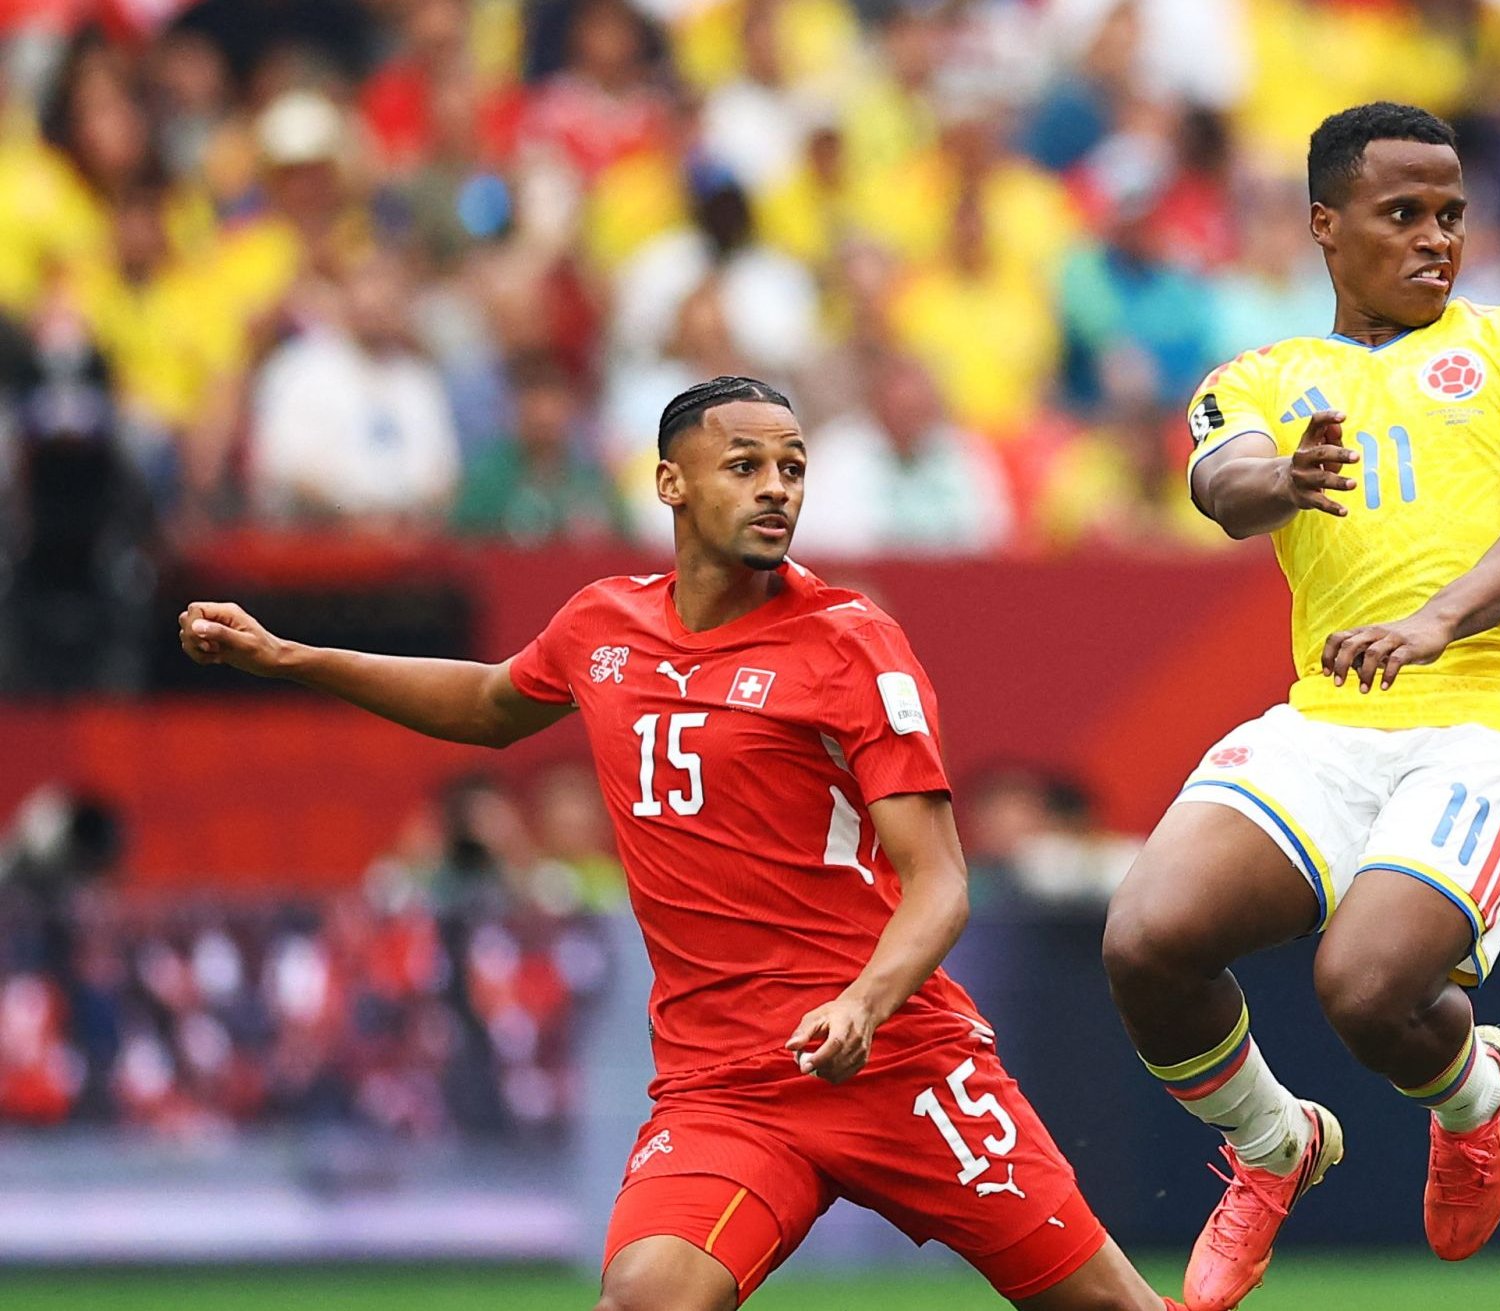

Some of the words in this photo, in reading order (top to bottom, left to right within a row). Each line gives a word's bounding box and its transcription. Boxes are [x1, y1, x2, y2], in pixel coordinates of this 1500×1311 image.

[1356, 425, 1416, 510] 11
[632, 712, 709, 816] 15
[1431, 782, 1490, 866] 11
[914, 1057, 1017, 1187] 15
